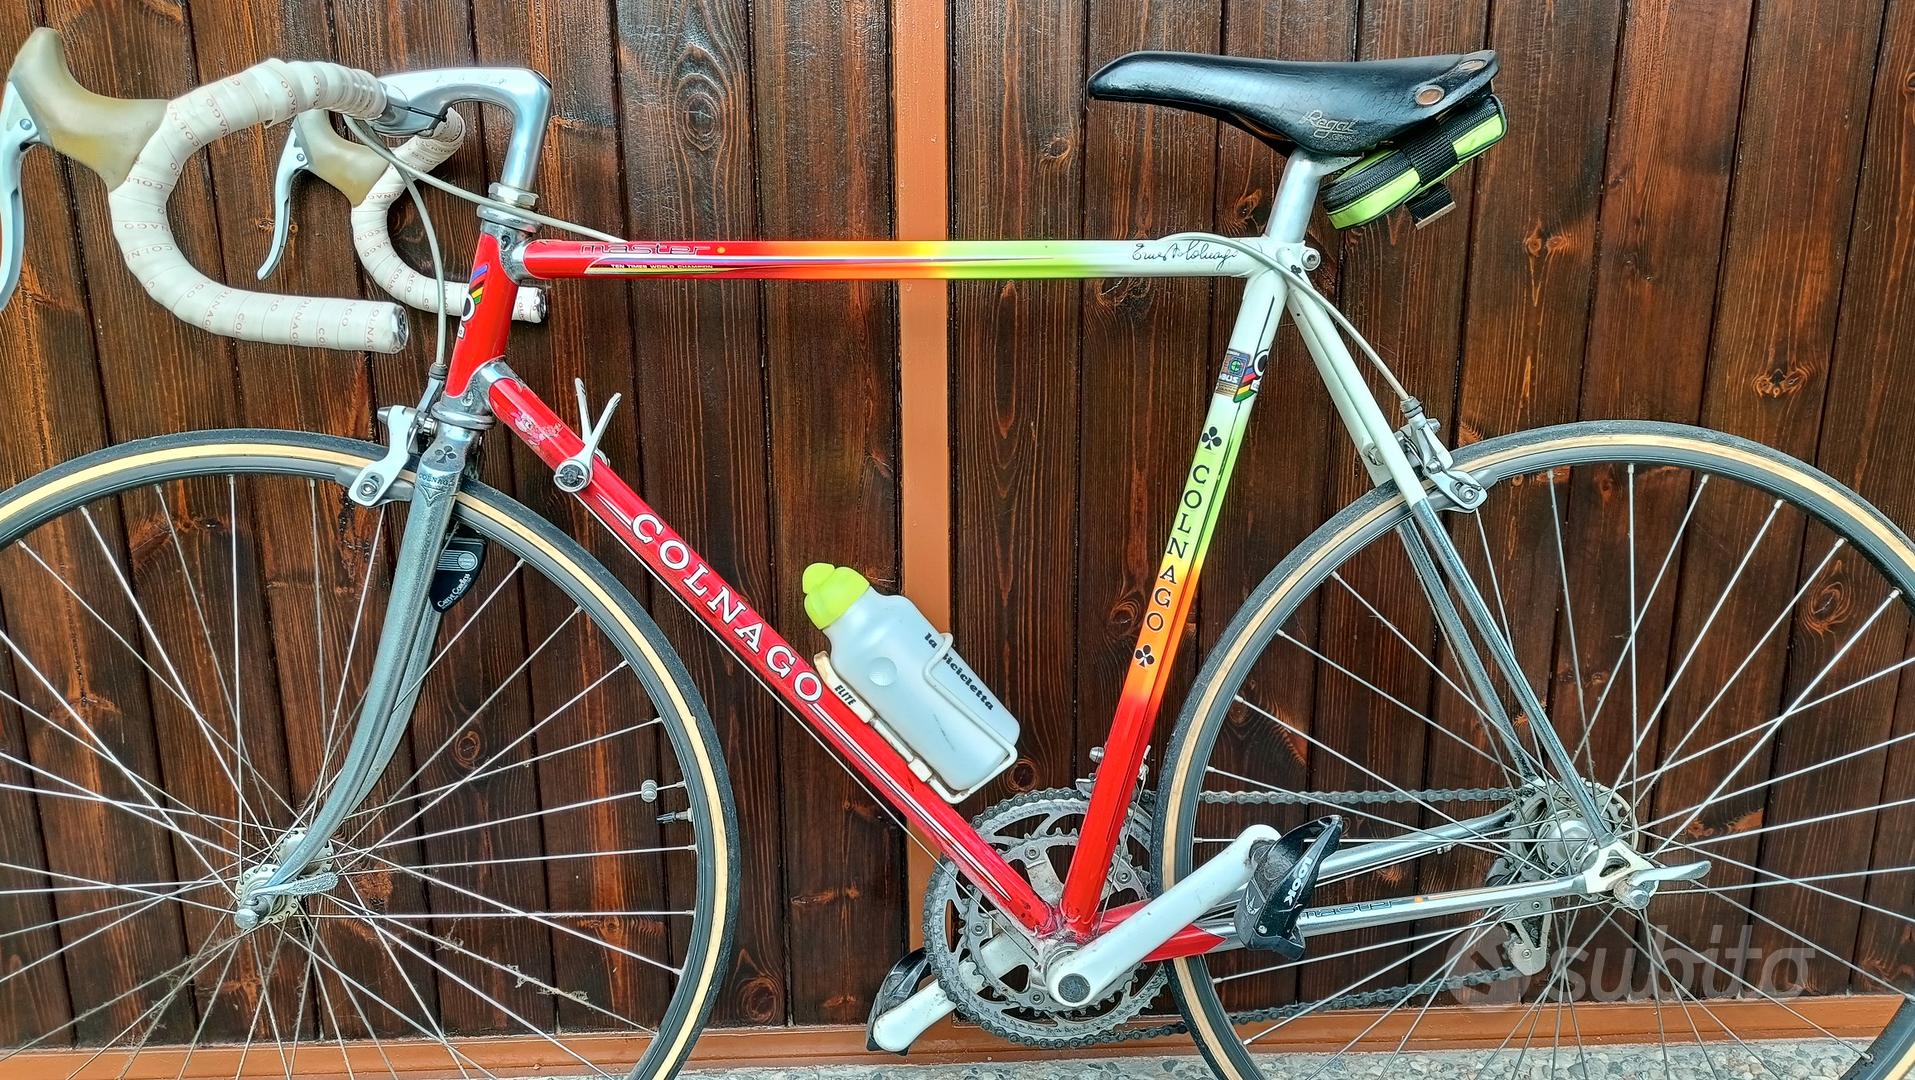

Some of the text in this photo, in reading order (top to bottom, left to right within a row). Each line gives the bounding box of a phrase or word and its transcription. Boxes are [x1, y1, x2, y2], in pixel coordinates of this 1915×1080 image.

[1299, 109, 1360, 139] Regal
[579, 242, 711, 255] master
[1146, 464, 1210, 632] COLNAGO
[631, 513, 823, 702] COLNAGO
[924, 632, 938, 649] la
[834, 684, 857, 706] ELITE
